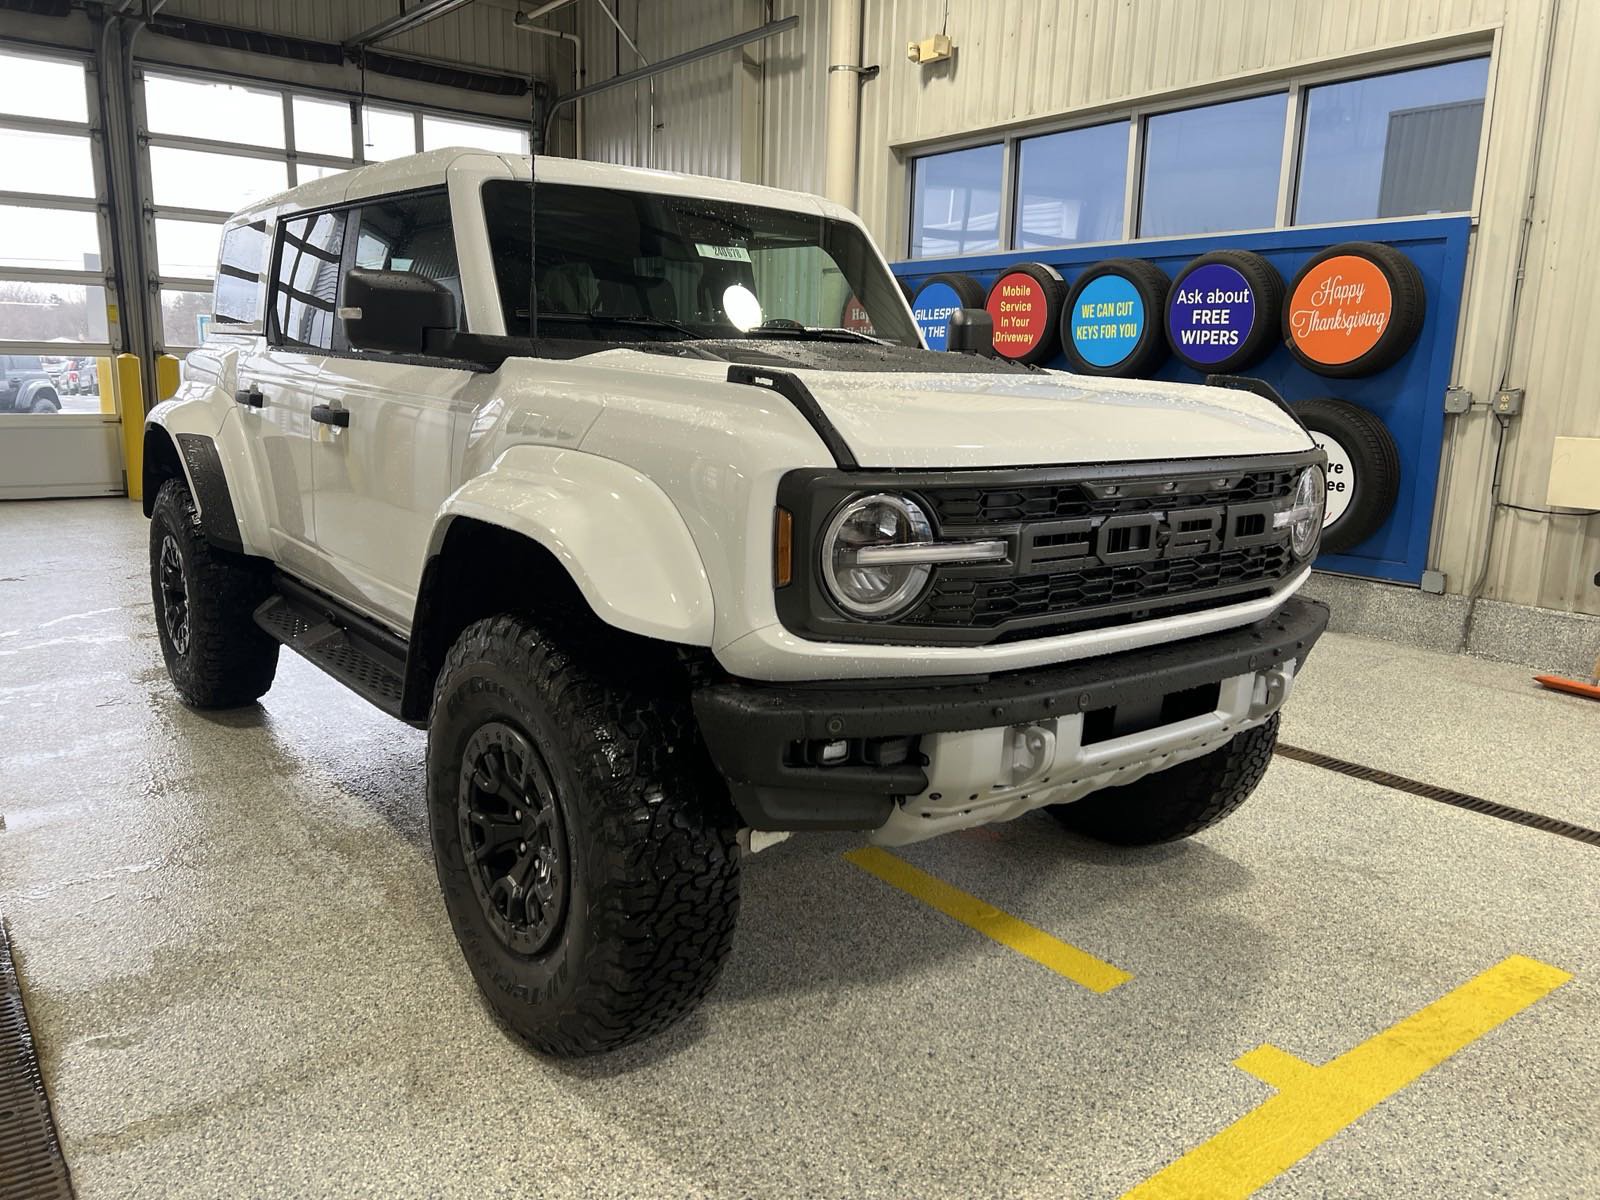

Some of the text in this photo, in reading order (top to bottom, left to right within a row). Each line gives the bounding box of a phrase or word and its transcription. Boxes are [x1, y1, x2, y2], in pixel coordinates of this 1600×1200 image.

[1002, 285, 1031, 297] Mobile
[1176, 288, 1249, 304] Ask about
[1311, 275, 1366, 307] Happy
[1000, 301, 1032, 312] Service
[1081, 301, 1134, 318] WE CAN CUT
[1001, 316, 1030, 327] In Your
[1192, 309, 1231, 325] FREE
[1291, 308, 1386, 338] Thanksgiving
[928, 326, 946, 338] THE
[995, 331, 1034, 345] Driveway
[1076, 323, 1137, 340] KEYS FOR YOU
[1181, 330, 1239, 345] WIPERS
[1018, 501, 1275, 576] FORD
